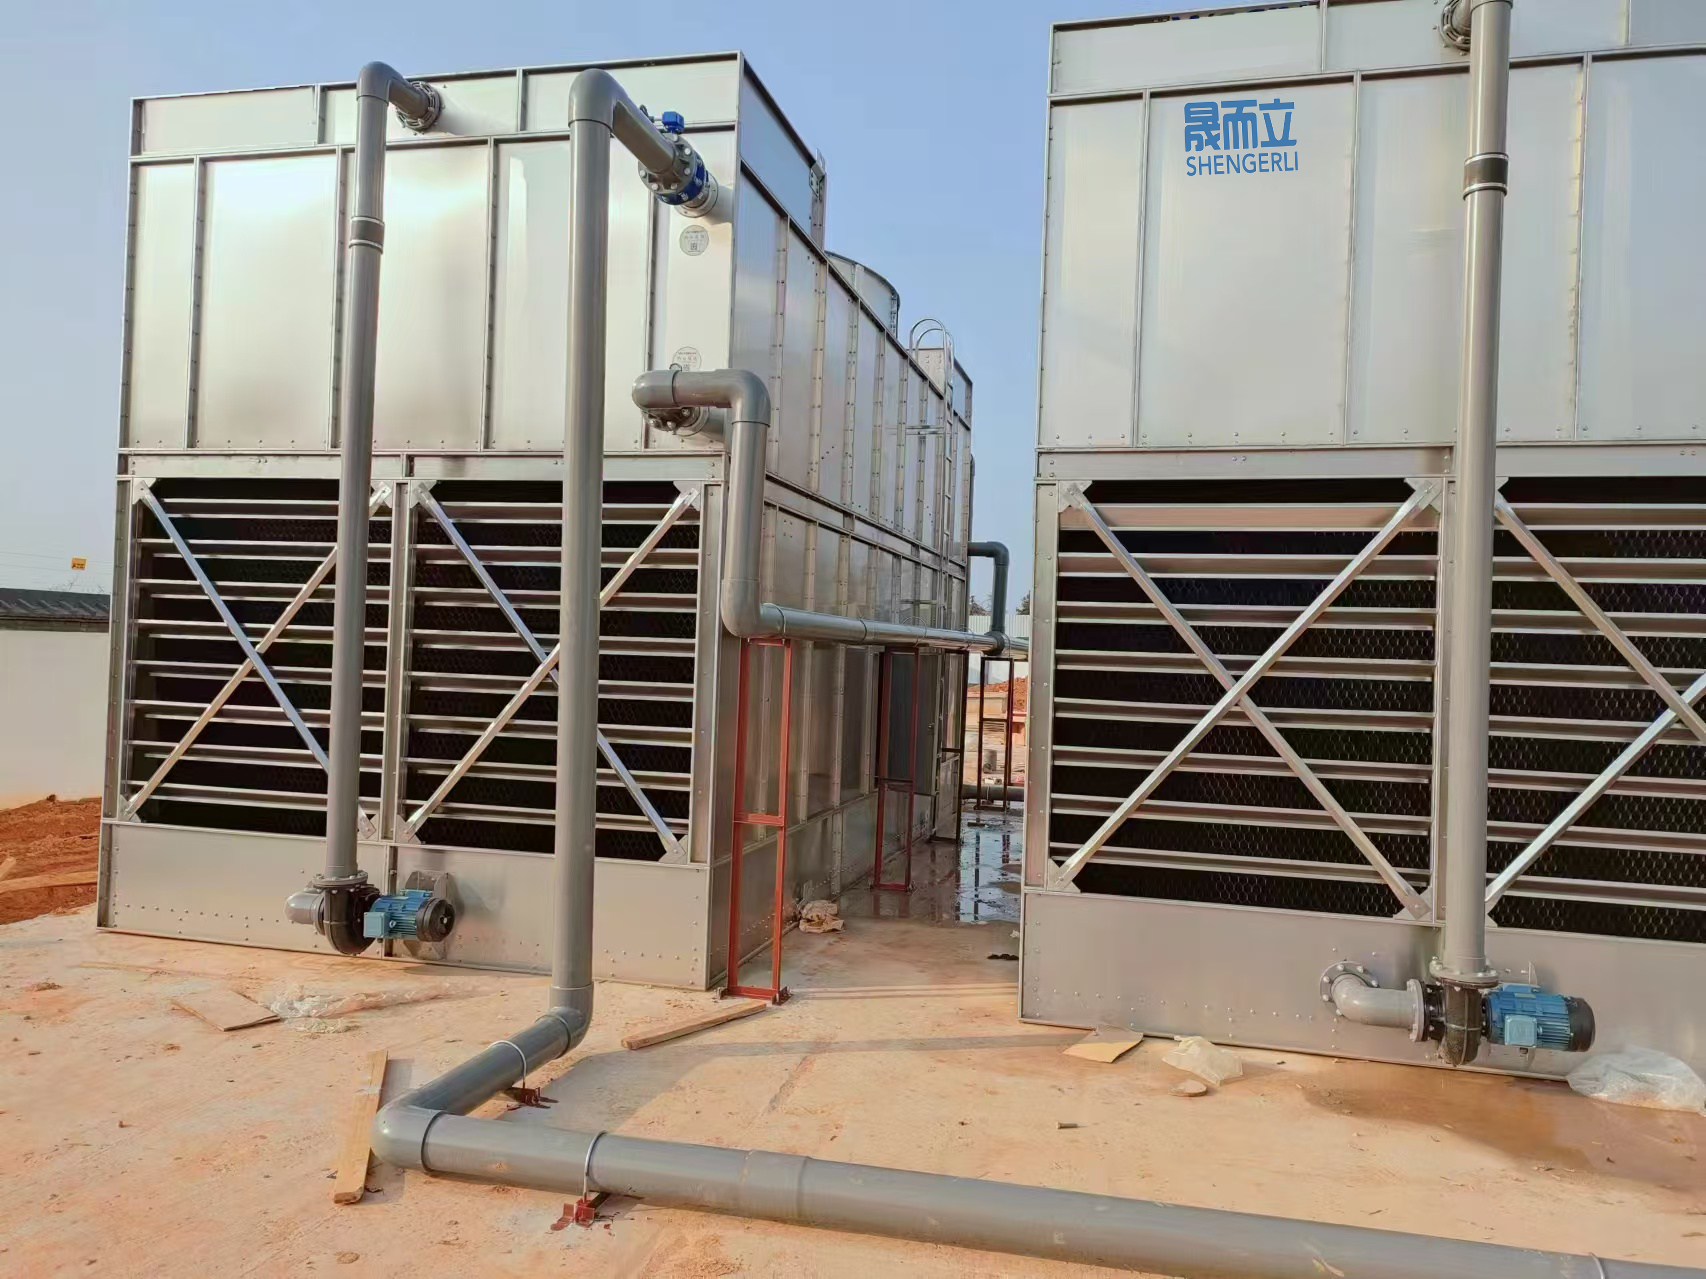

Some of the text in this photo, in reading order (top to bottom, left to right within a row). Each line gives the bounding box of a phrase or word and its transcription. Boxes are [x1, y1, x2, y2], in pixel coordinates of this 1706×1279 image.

[1184, 98, 1297, 152] 晟而立
[1186, 151, 1299, 177] SHENGERLI
